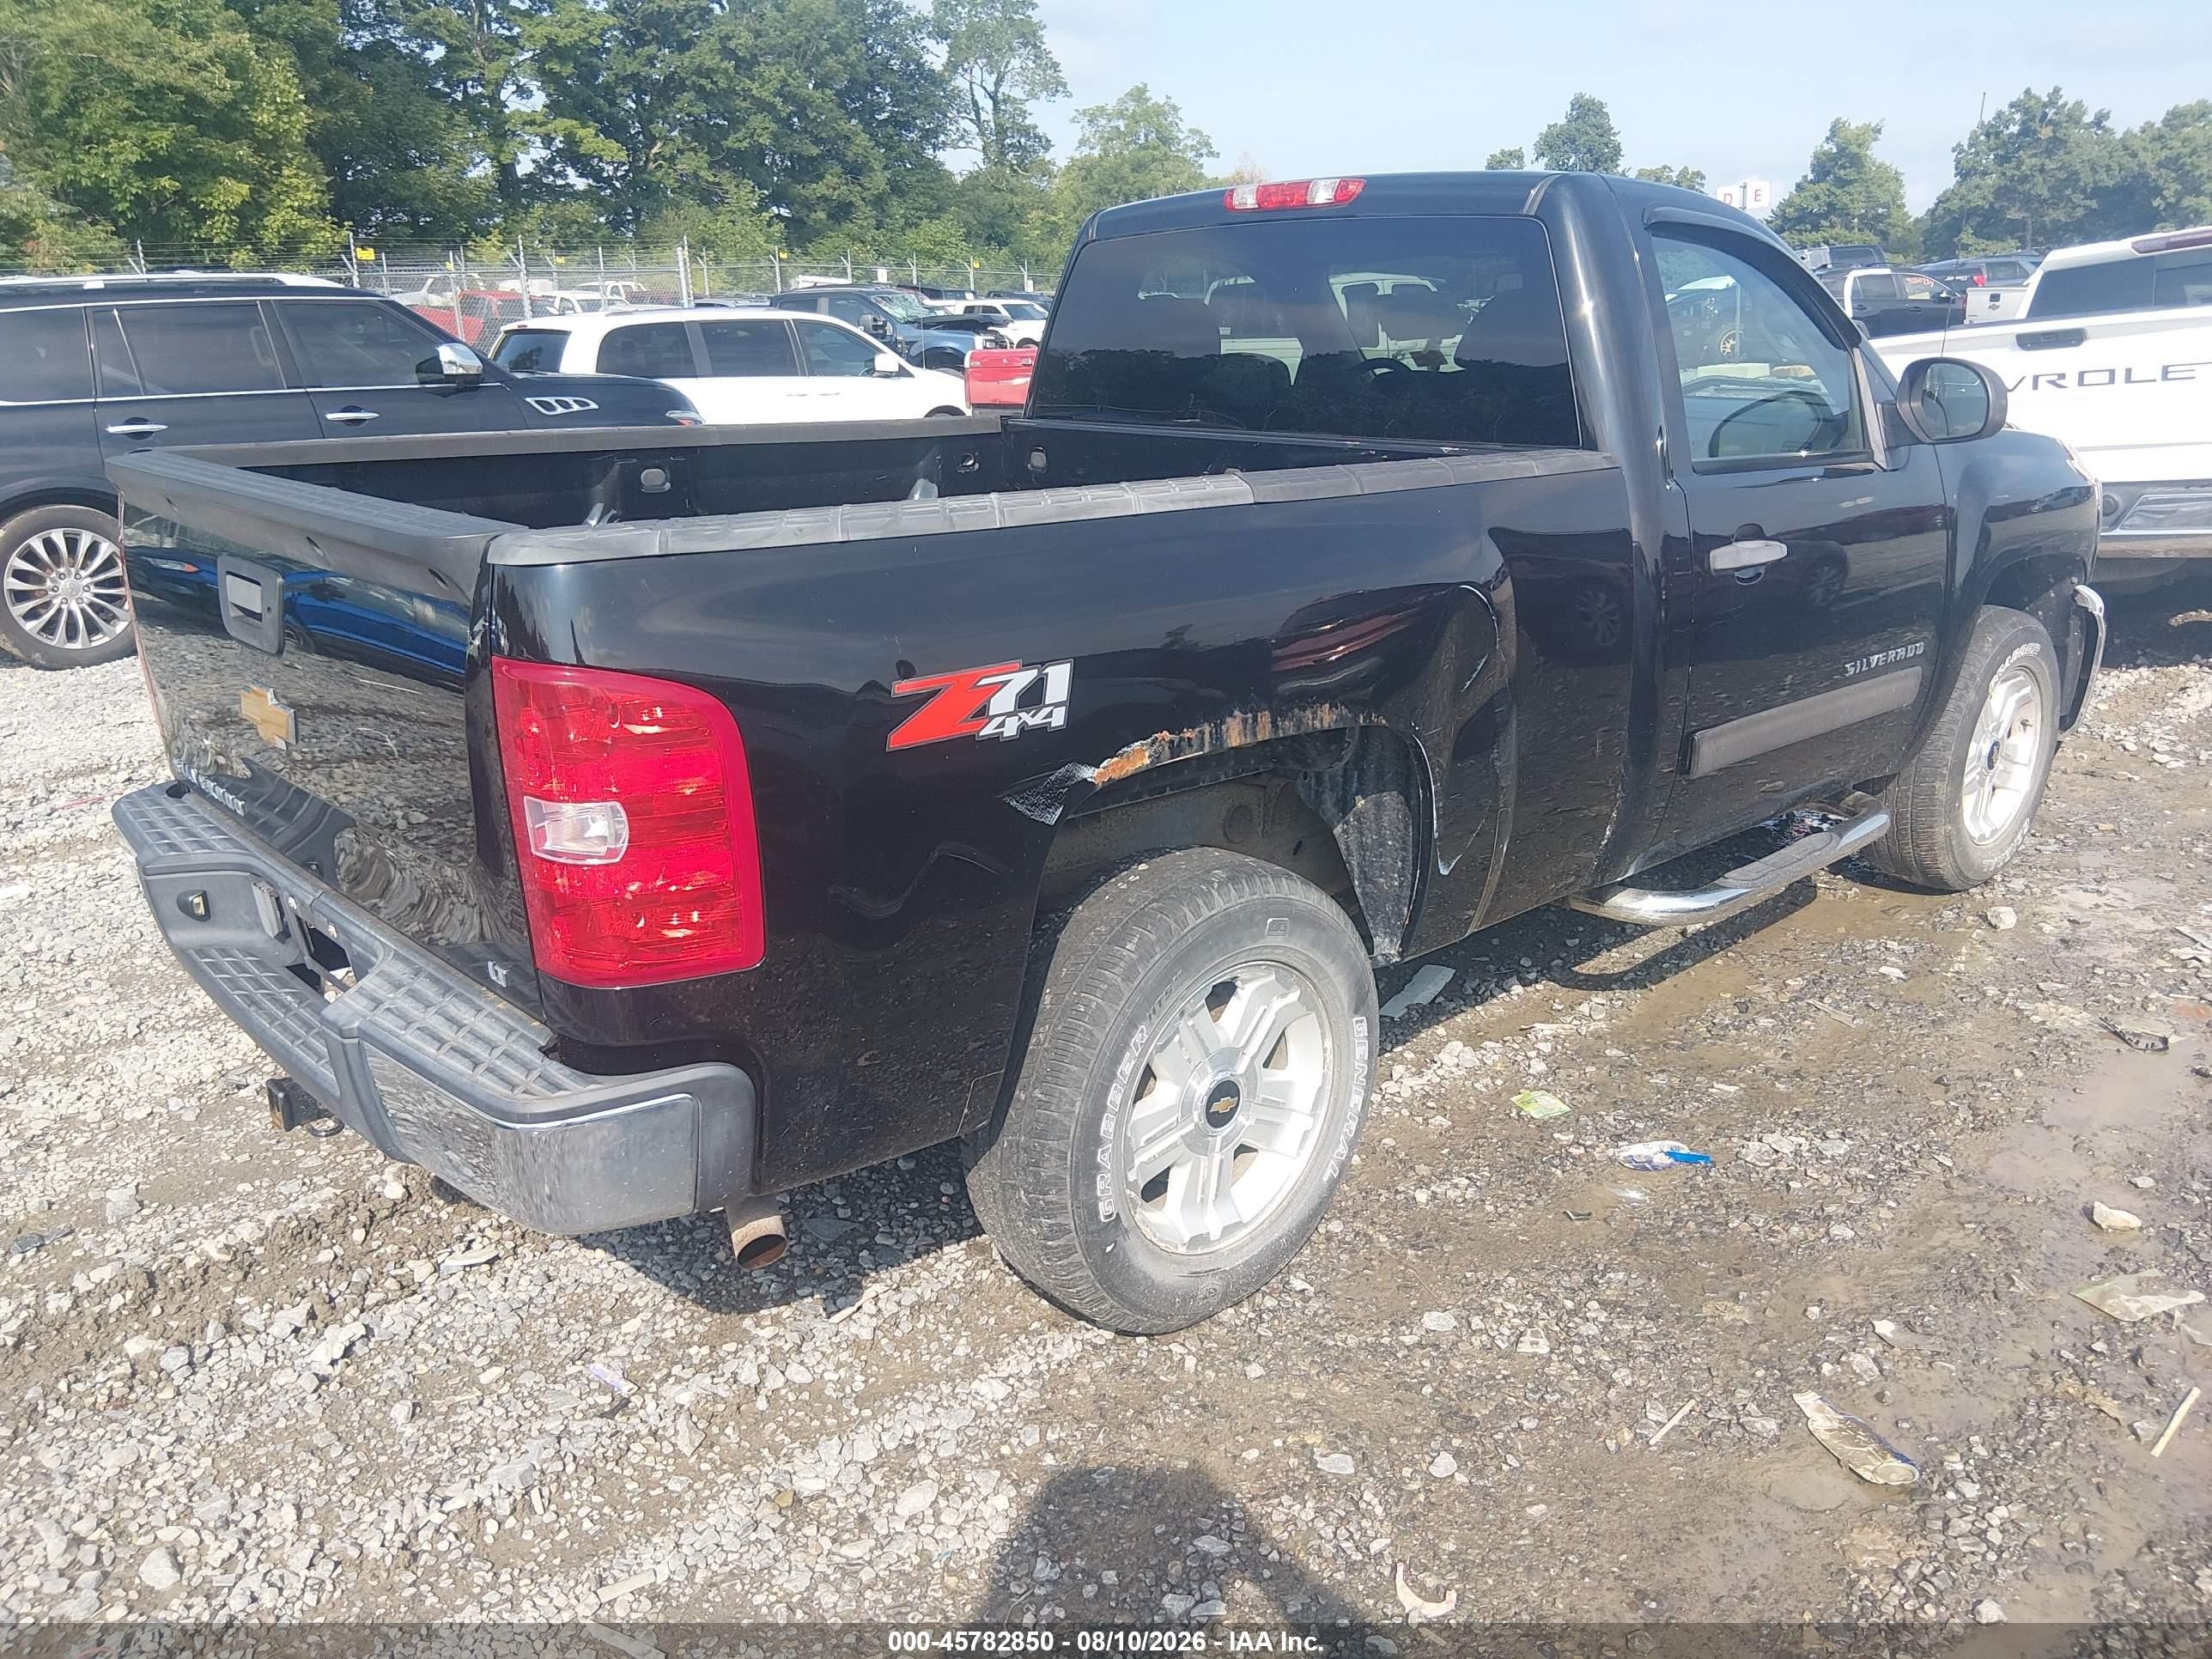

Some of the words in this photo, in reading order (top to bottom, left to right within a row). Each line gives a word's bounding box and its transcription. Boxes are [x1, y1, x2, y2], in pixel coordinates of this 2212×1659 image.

[2007, 362, 2212, 392] VROLE
[887, 659, 1073, 751] Z71
[1843, 641, 1924, 677] SILVERADO
[1097, 1024, 1149, 1222] GRABBER
[1322, 1016, 1369, 1182] GENERAL
